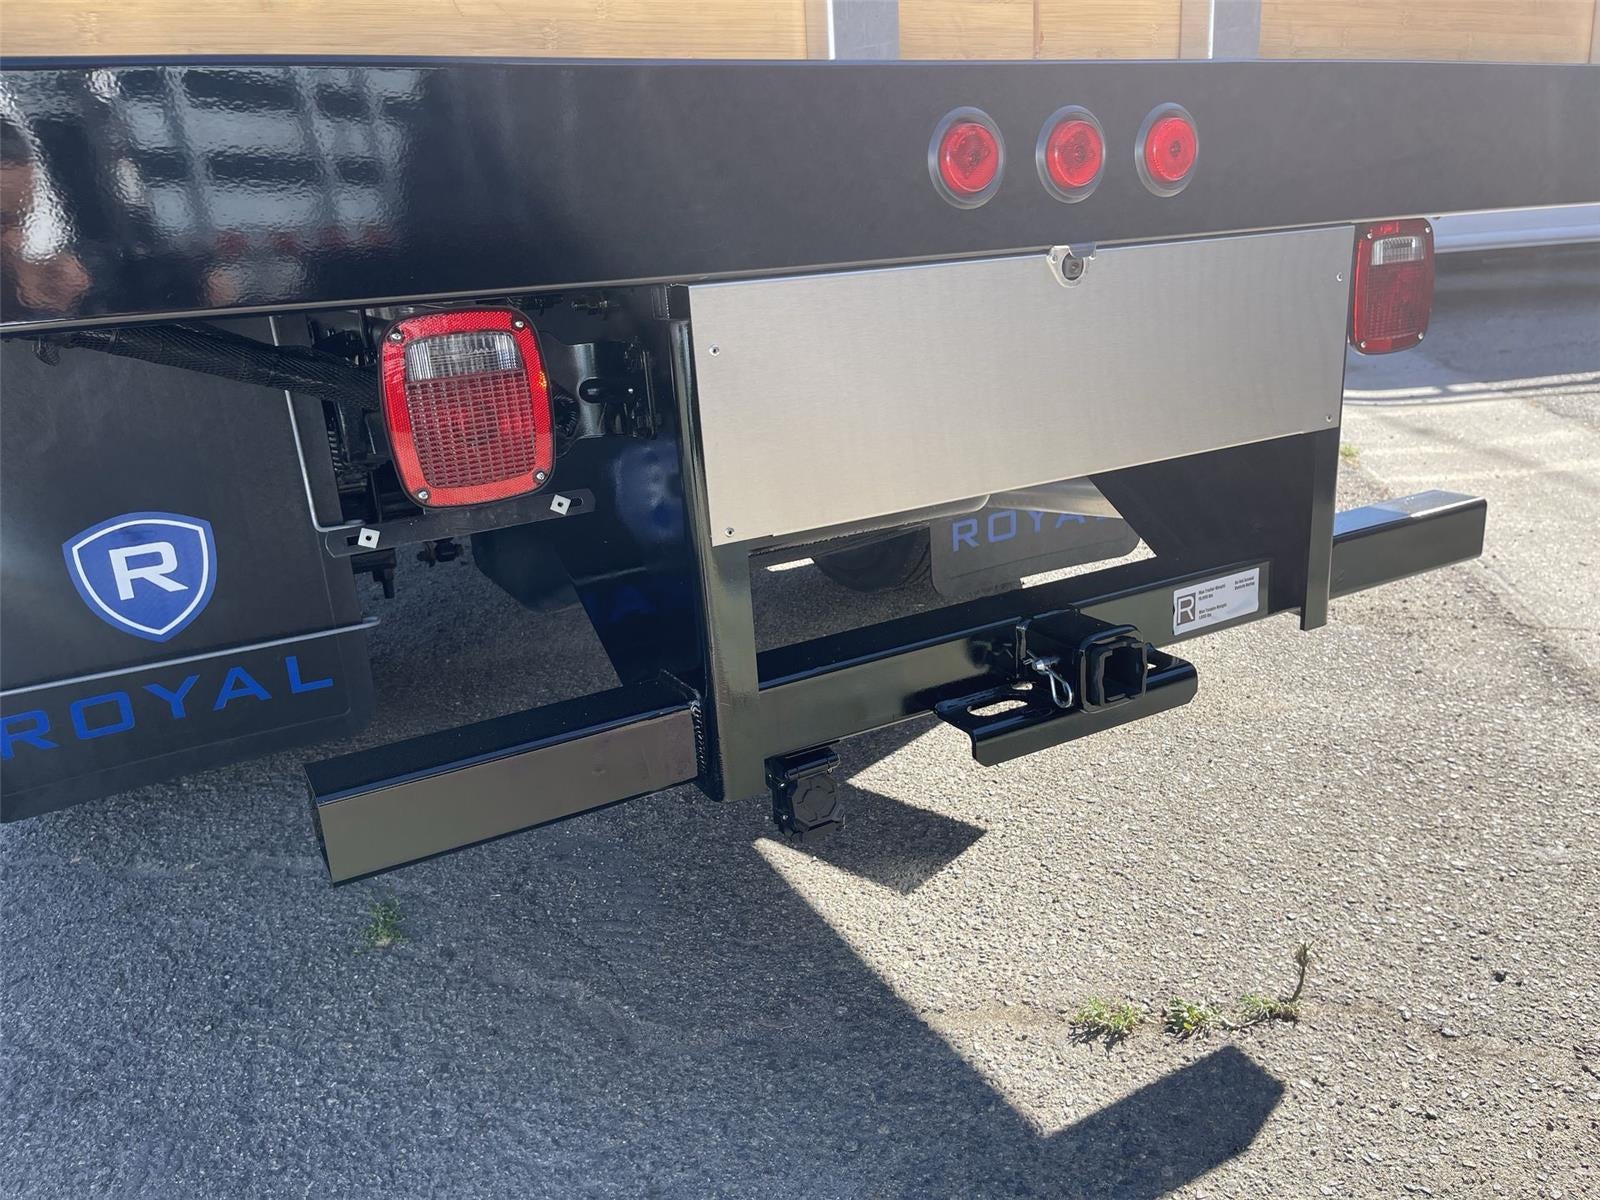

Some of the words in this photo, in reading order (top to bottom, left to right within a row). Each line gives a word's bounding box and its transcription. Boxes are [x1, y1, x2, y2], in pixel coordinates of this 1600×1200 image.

[952, 510, 1104, 552] ROY
[108, 541, 189, 600] R
[1178, 596, 1194, 624] R
[0, 655, 334, 760] ROYAL
